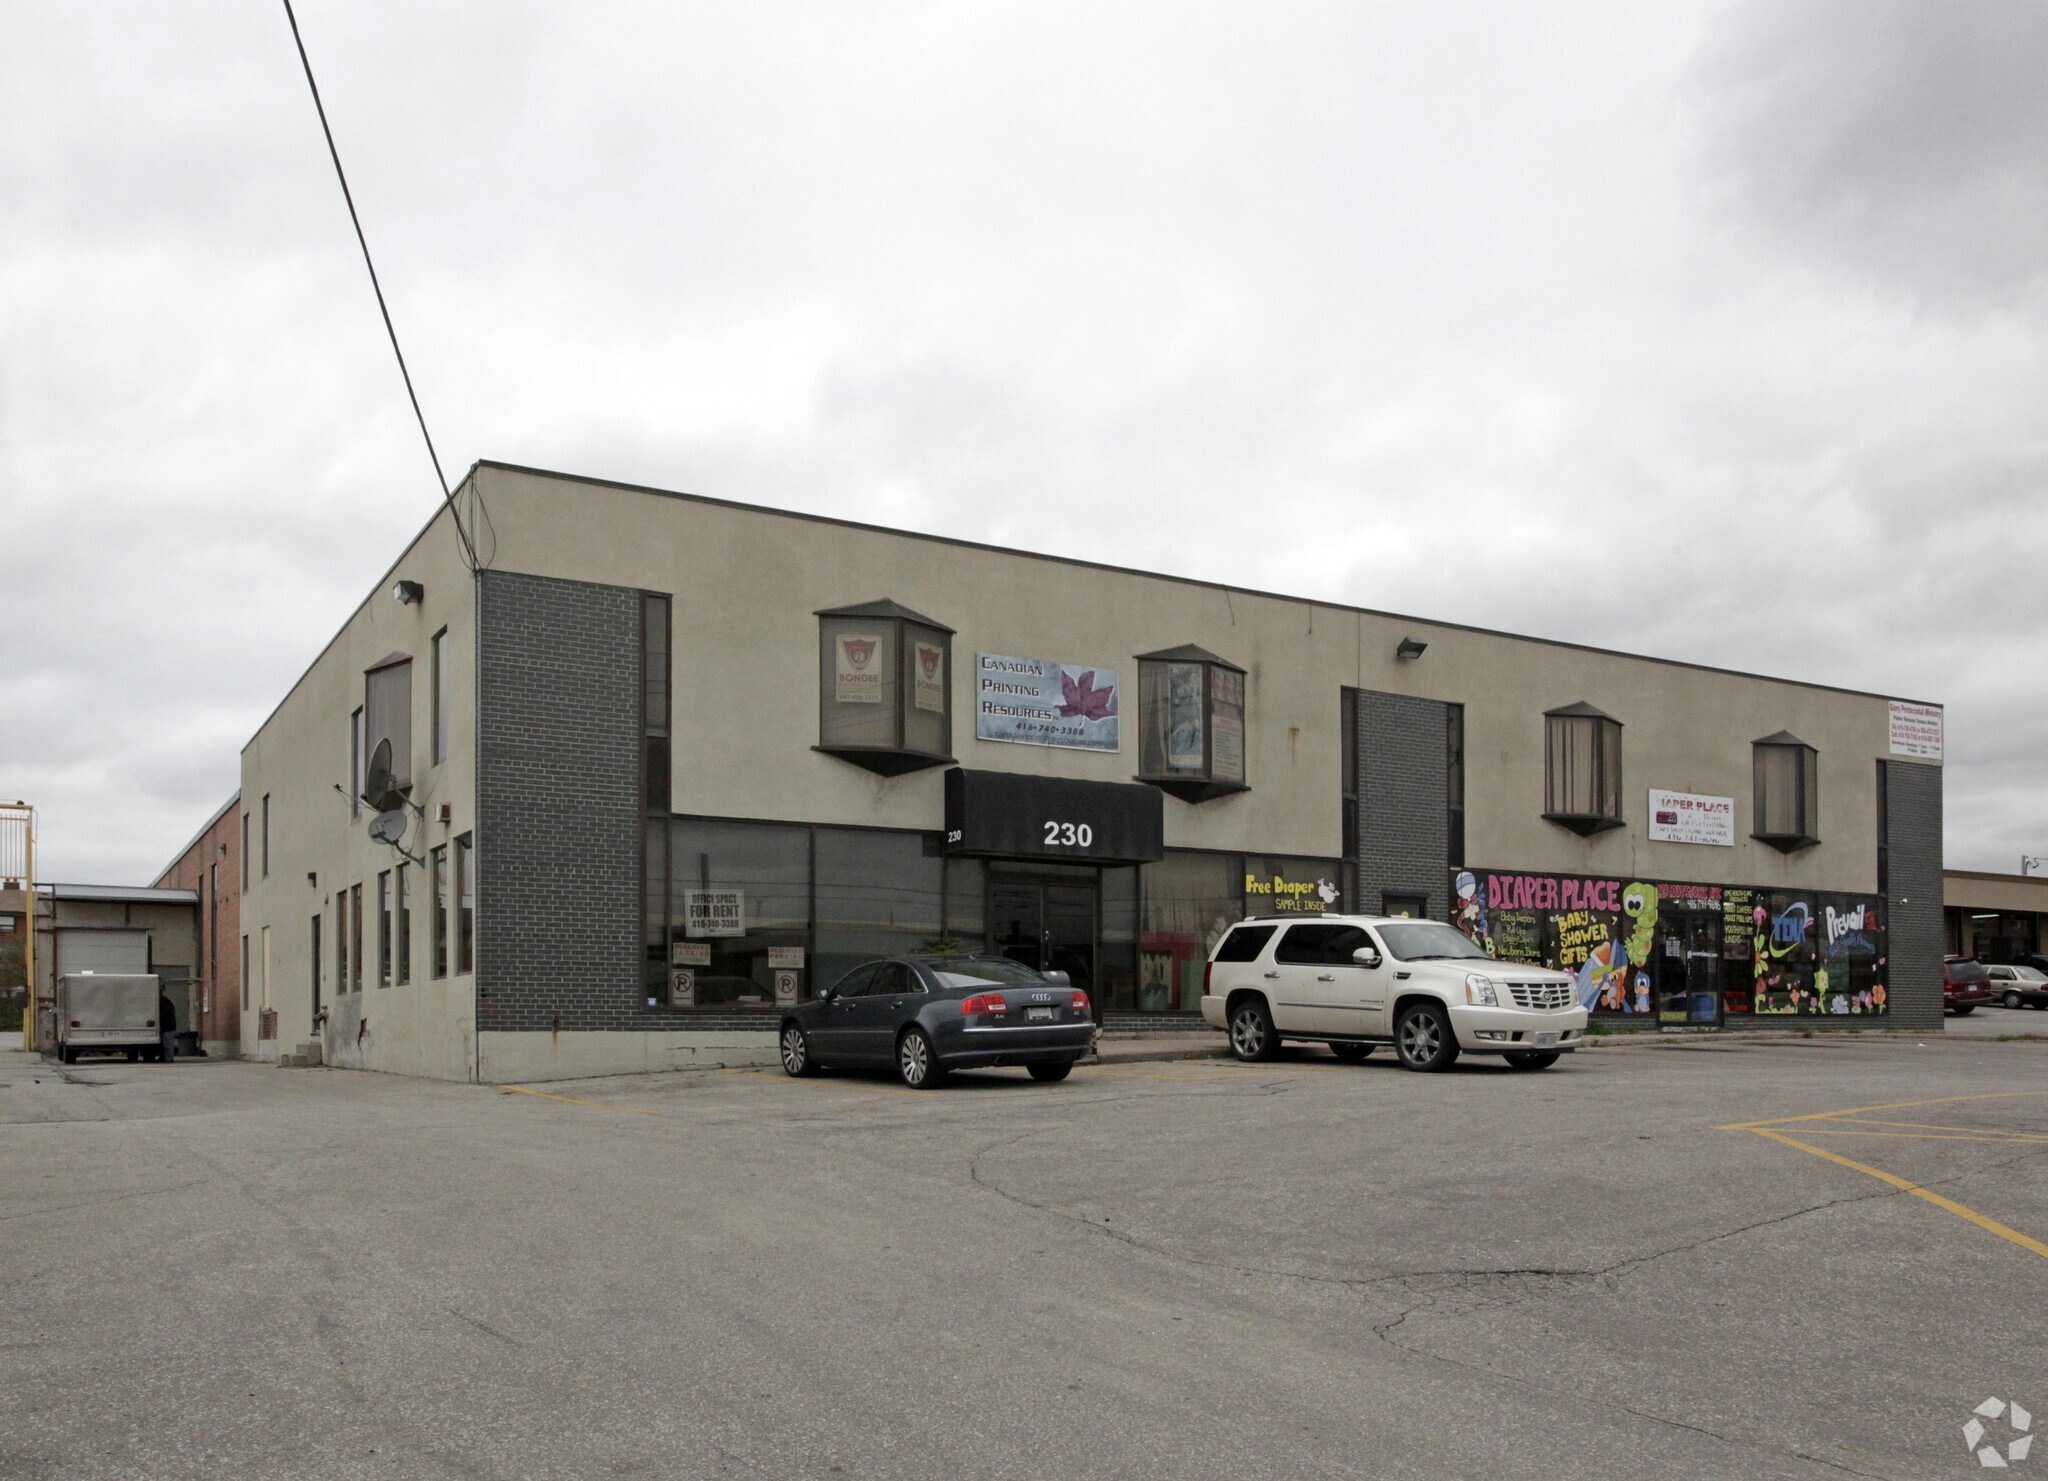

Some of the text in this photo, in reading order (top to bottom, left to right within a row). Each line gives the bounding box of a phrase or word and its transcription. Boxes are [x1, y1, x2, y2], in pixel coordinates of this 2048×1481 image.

[982, 656, 1043, 676] CANADIAN
[839, 673, 879, 683] BONDEE
[917, 679, 943, 694] BONDEE
[982, 679, 1040, 697] PRINTING
[982, 701, 1052, 720] RESOURCES
[1696, 801, 1729, 814] PLACE
[948, 829, 962, 843] 230
[1043, 821, 1093, 847] 230
[1246, 874, 1314, 900] Free Diaper
[1488, 875, 1621, 912] DIAPER PLACE
[692, 894, 737, 904] OFFICE SPACE
[1275, 898, 1327, 912] SAMPLE INSIDE
[690, 905, 740, 918] FOR RENT
[1500, 910, 1536, 926] Baby Diapers
[692, 919, 740, 928] 416-740-3388
[1558, 911, 1589, 933] BABY
[1825, 903, 1866, 945] Prevail
[1560, 923, 1609, 947] SHOWER
[1498, 944, 1525, 956] Newborn
[1560, 946, 1588, 965] GIFTS
